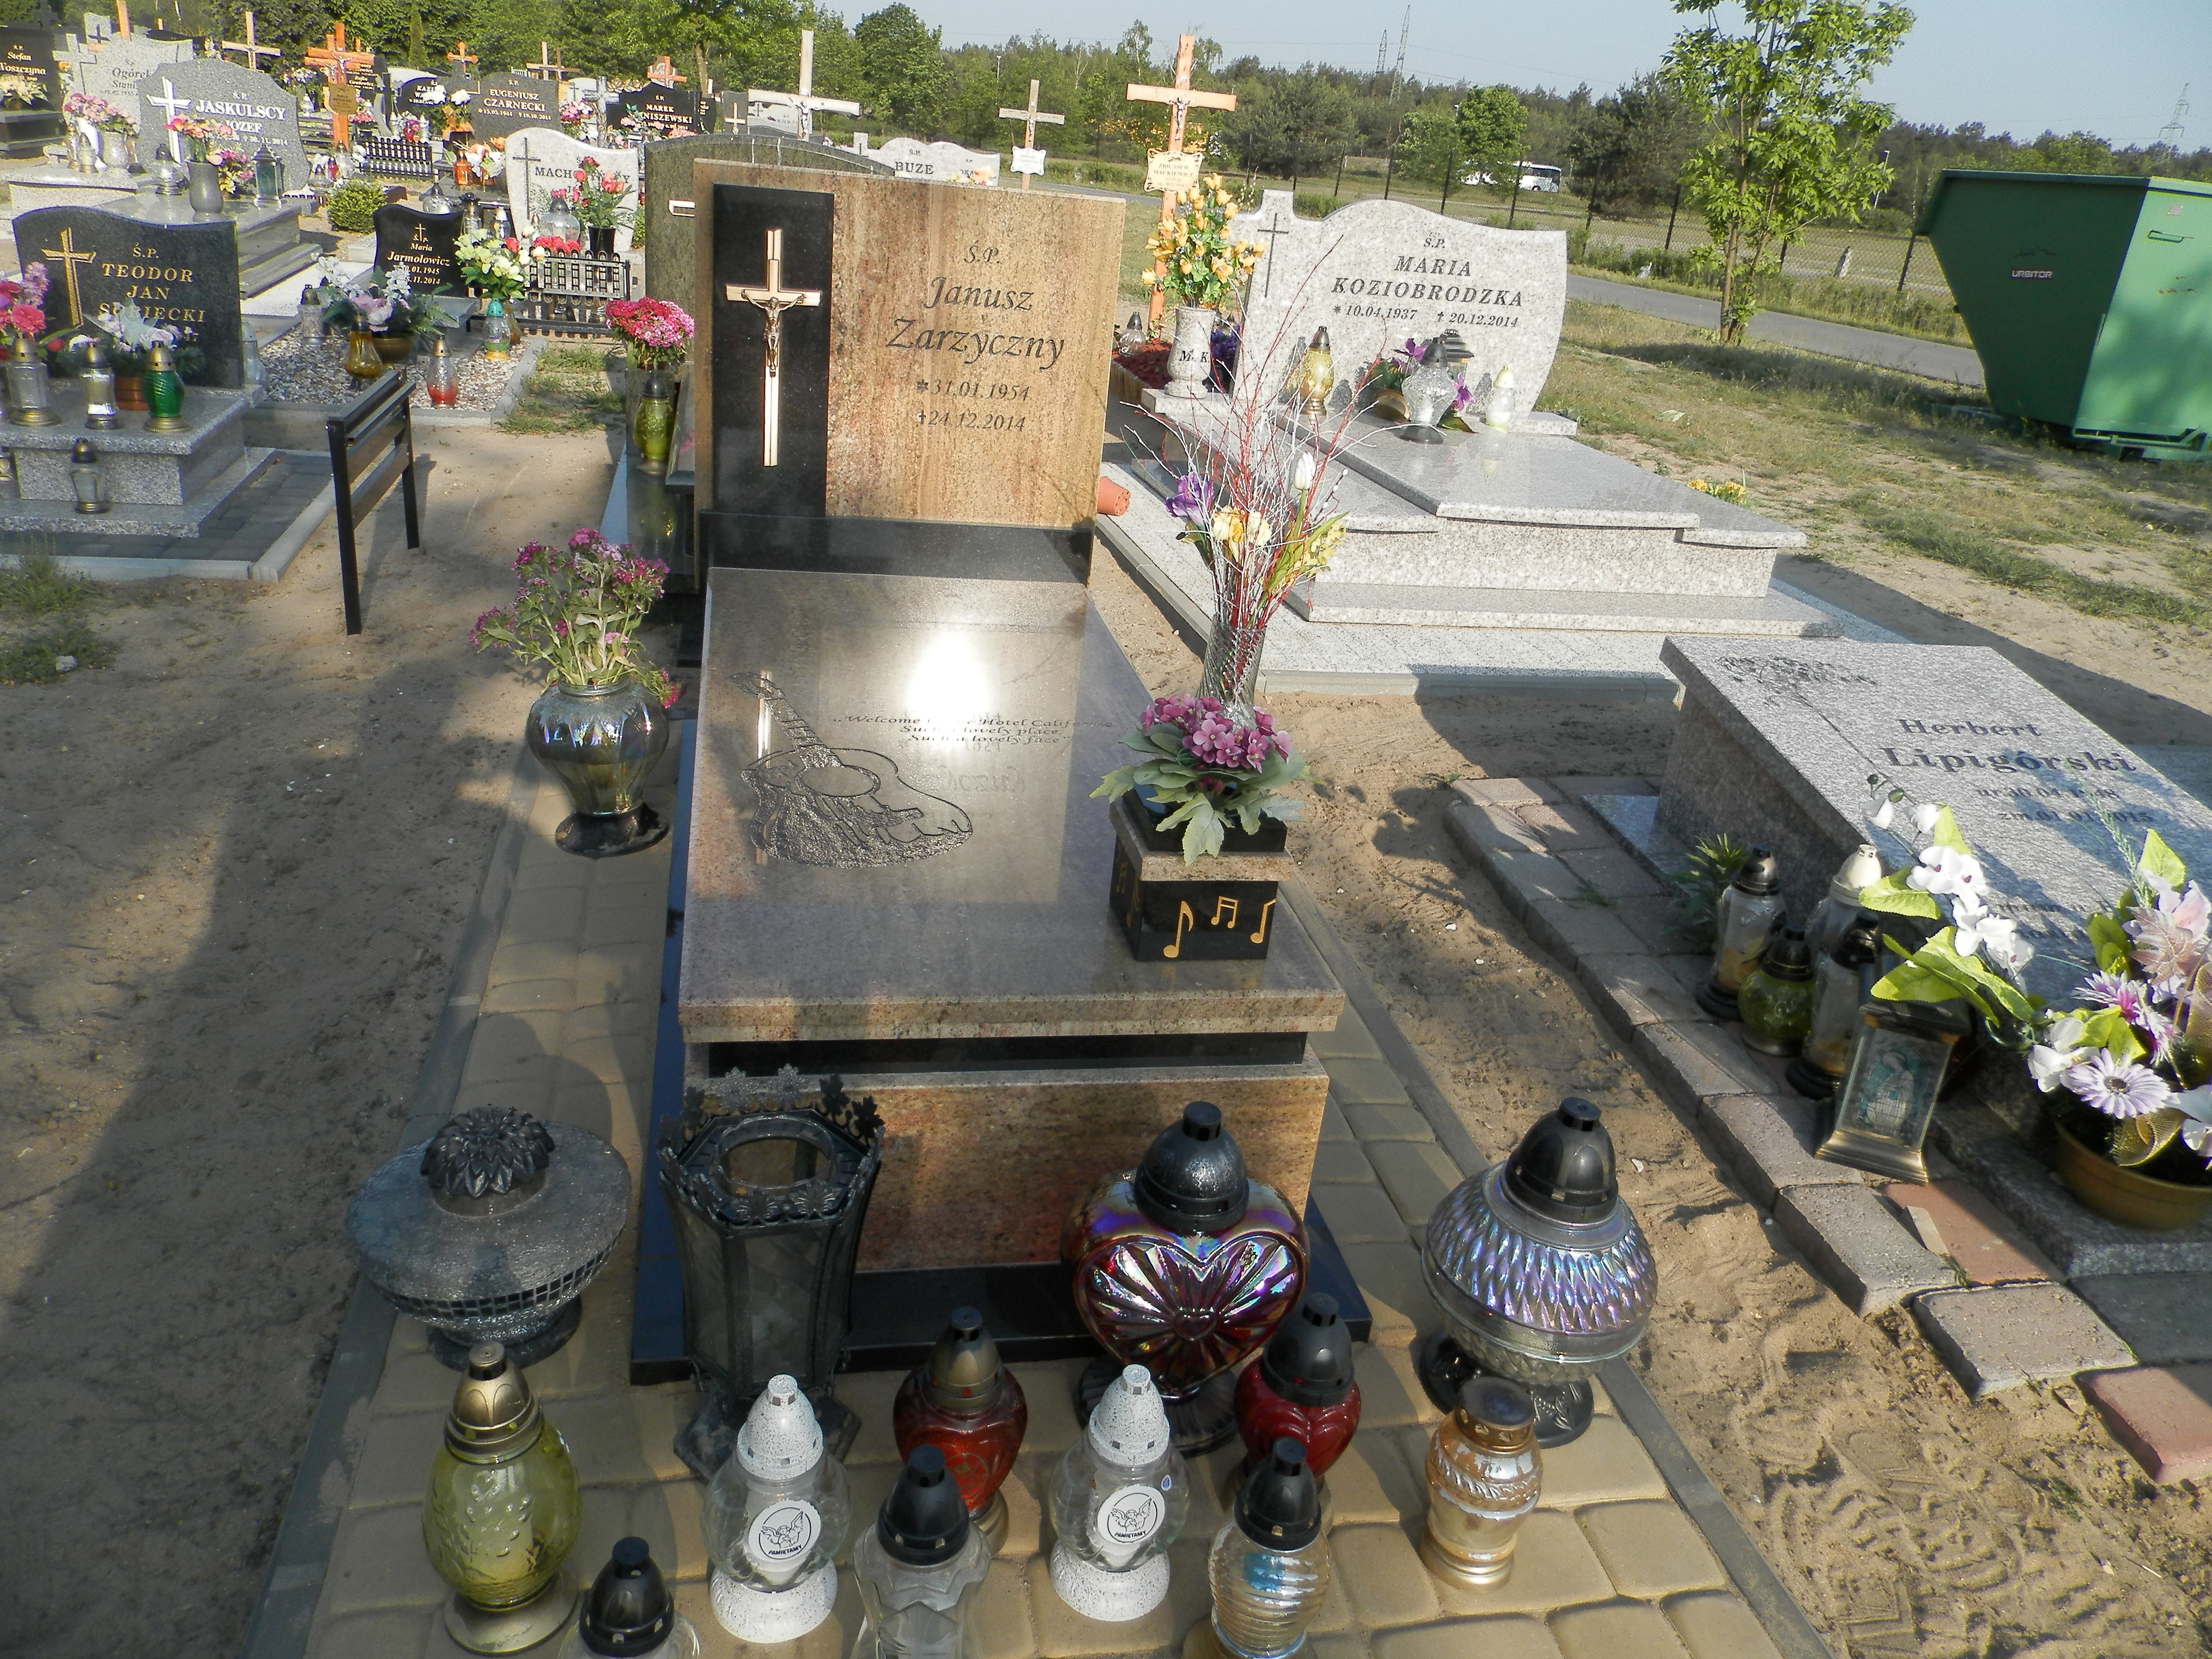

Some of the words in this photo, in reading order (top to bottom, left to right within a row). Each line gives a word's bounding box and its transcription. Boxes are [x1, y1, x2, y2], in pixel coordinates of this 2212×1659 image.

[7, 51, 32, 61] Stefan
[489, 88, 539, 101] EUGENIUSZ
[195, 99, 286, 120] JASKULSCY
[483, 98, 546, 112] CZARNECKI
[646, 103, 674, 113] MAREK
[642, 111, 693, 124] NISZEWSKI
[895, 161, 934, 175] BUZE
[410, 242, 433, 252] Maria
[102, 263, 193, 283] TEODOR
[404, 265, 440, 275] 0.01.1945
[1394, 256, 1471, 276] MARIA
[2012, 270, 2053, 278] URBITOR
[126, 285, 170, 300] JAN
[924, 276, 1034, 311] Janusz
[1331, 277, 1523, 307] KOZIOBRODZKA
[99, 303, 205, 323] SIECKI
[1448, 313, 1520, 327] 20.12.2014
[886, 318, 1065, 371] Zarzyczny
[930, 379, 1030, 402] 31.01.1954
[927, 410, 1026, 432] 24.12.2014
[964, 727, 1011, 735] lovely
[1896, 720, 2042, 736] Herbert
[973, 735, 1021, 745] lovely
[1878, 747, 2136, 773] Lipigórski
